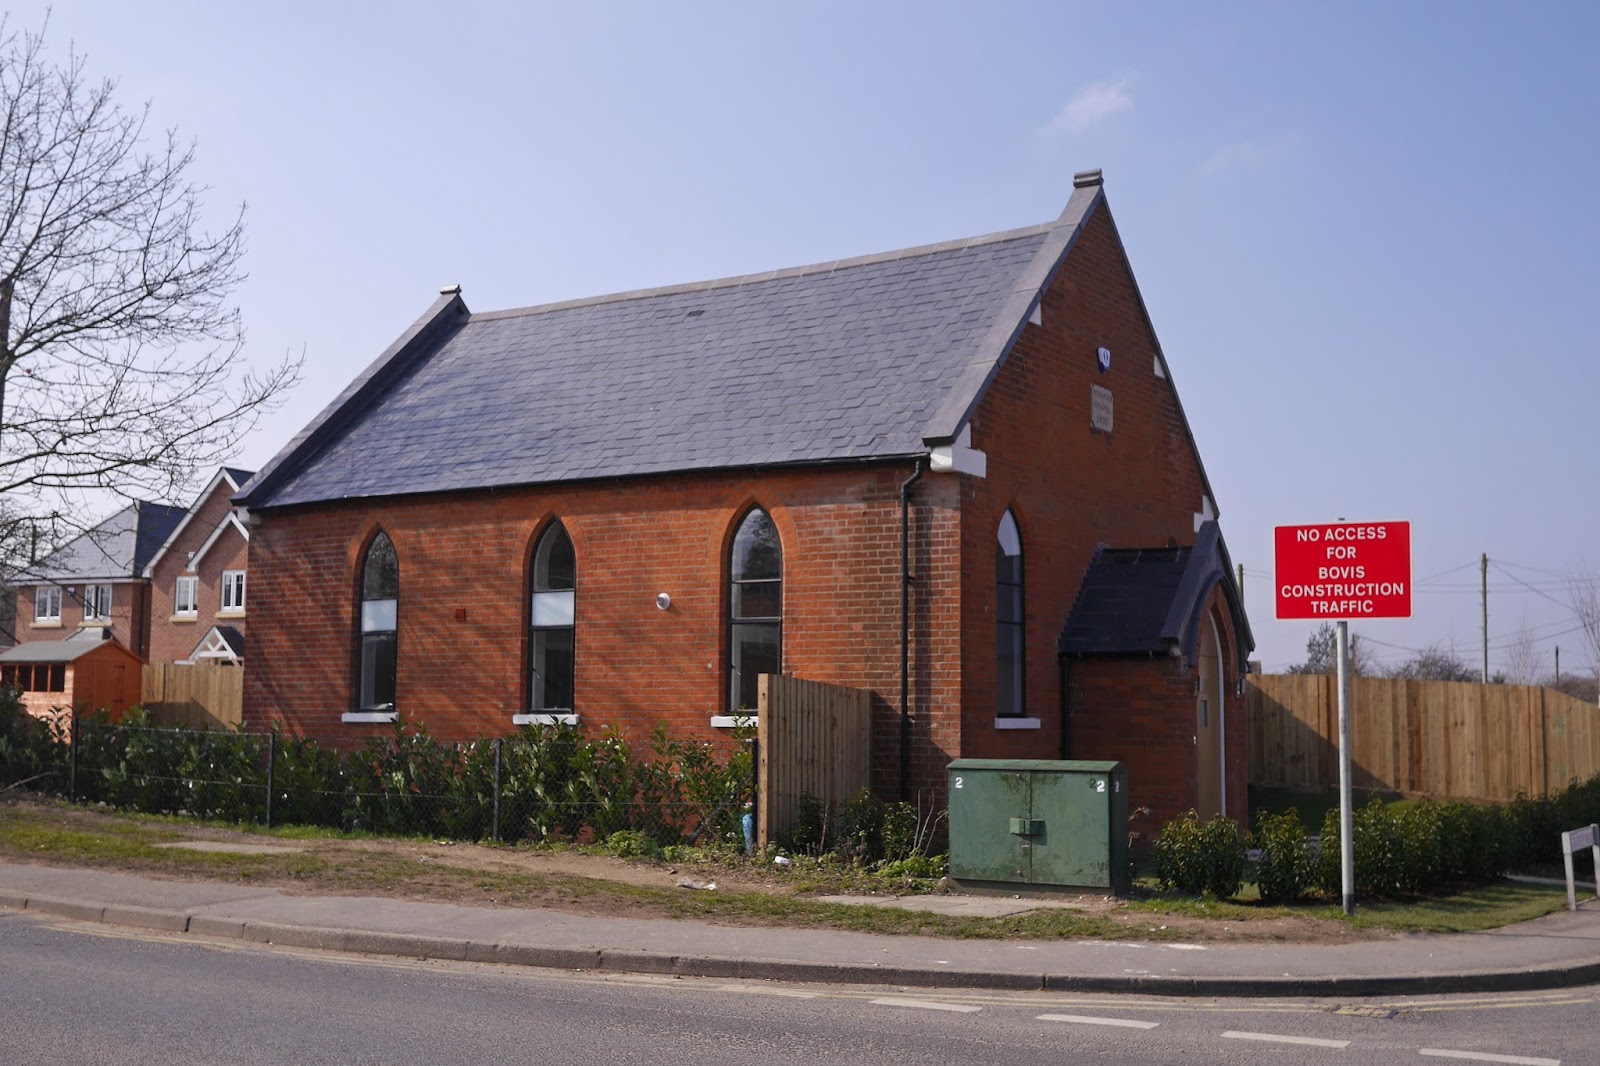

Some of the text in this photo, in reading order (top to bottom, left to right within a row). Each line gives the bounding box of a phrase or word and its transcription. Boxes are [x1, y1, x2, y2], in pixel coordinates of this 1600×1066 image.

[1297, 526, 1387, 542] NO ACCESS
[1326, 546, 1357, 559] FOR
[1318, 566, 1366, 579] BOVIS
[1281, 582, 1404, 598] CONSTRUCTION
[1311, 600, 1374, 613] TRAFFIC
[955, 776, 963, 789] 2
[1089, 777, 1097, 789] 2
[1096, 780, 1105, 793] 2
[1115, 780, 1120, 793] 2
